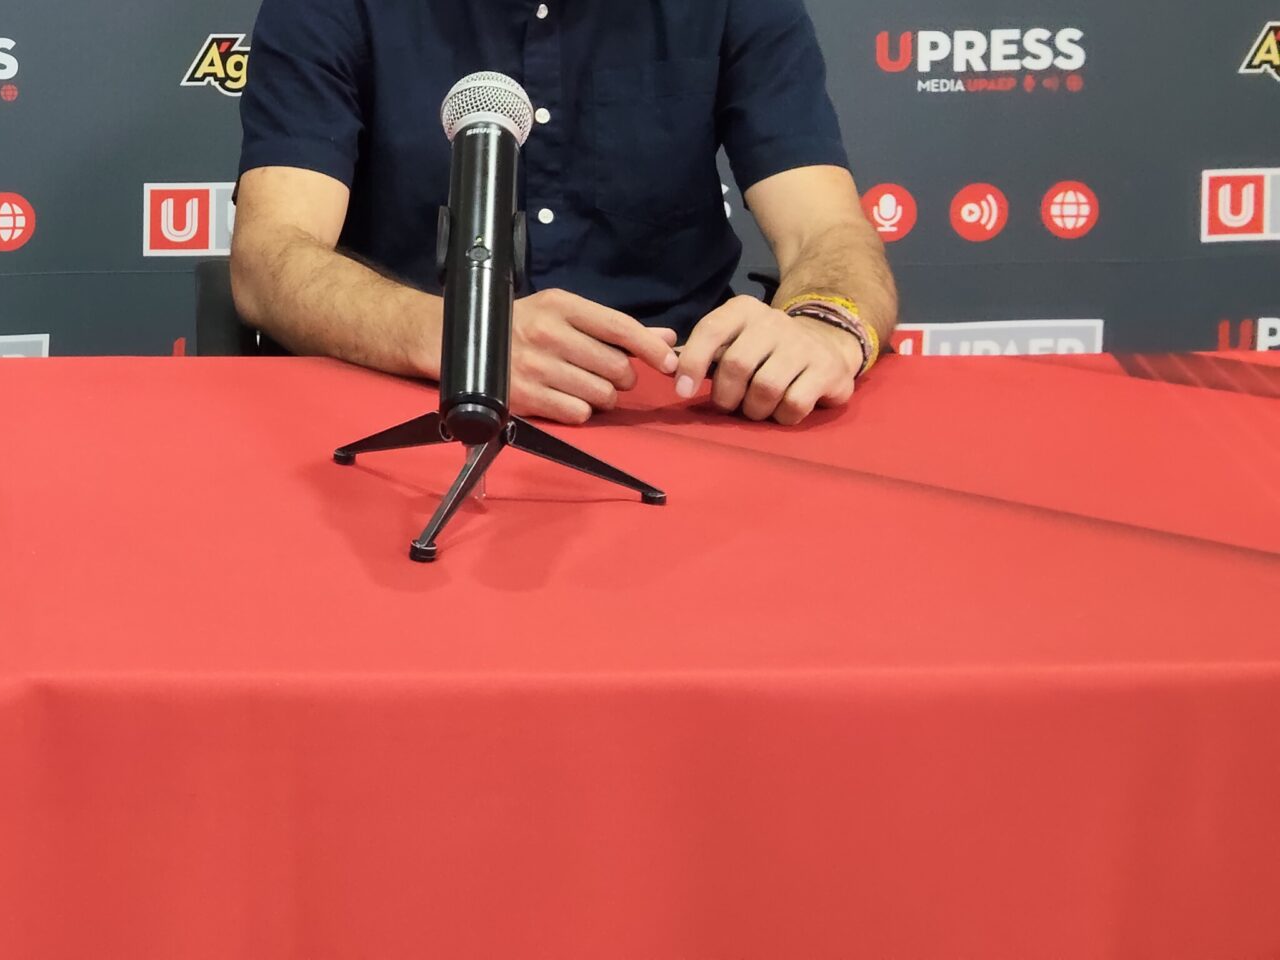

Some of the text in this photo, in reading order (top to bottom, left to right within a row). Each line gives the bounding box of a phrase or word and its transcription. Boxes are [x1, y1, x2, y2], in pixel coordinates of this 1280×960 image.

[876, 28, 1085, 72] UPRESS
[917, 79, 965, 92] MEDIA
[161, 198, 198, 242] U
[1218, 184, 1254, 227] U
